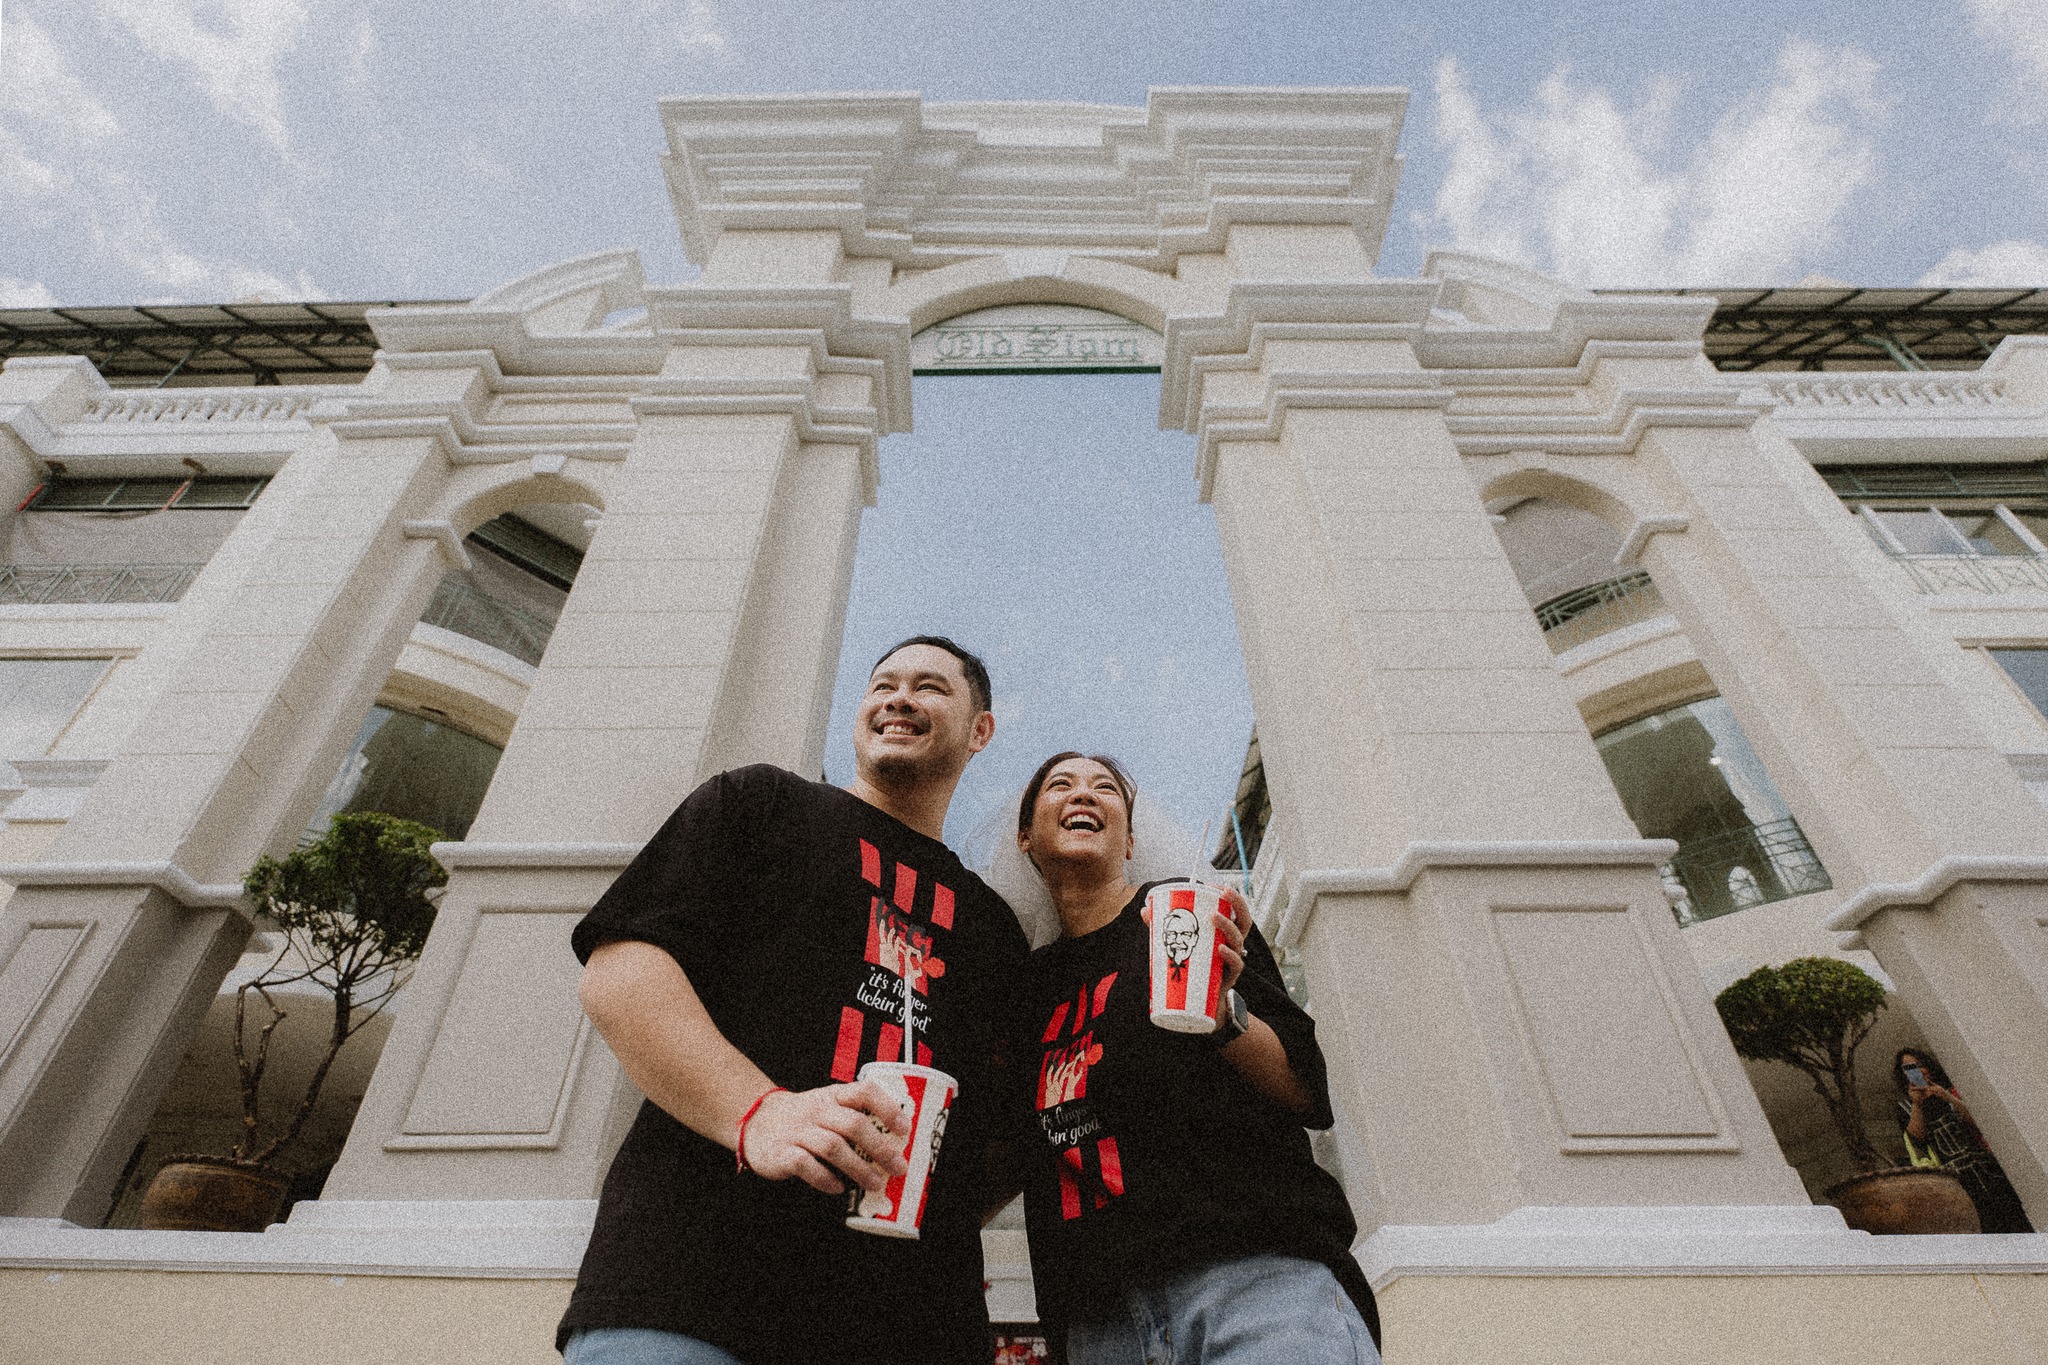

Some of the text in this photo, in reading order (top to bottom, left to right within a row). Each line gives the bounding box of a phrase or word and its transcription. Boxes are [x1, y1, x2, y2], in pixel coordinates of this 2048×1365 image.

[934, 325, 1141, 362] Old Siam
[856, 982, 932, 1034] lickin' god"
